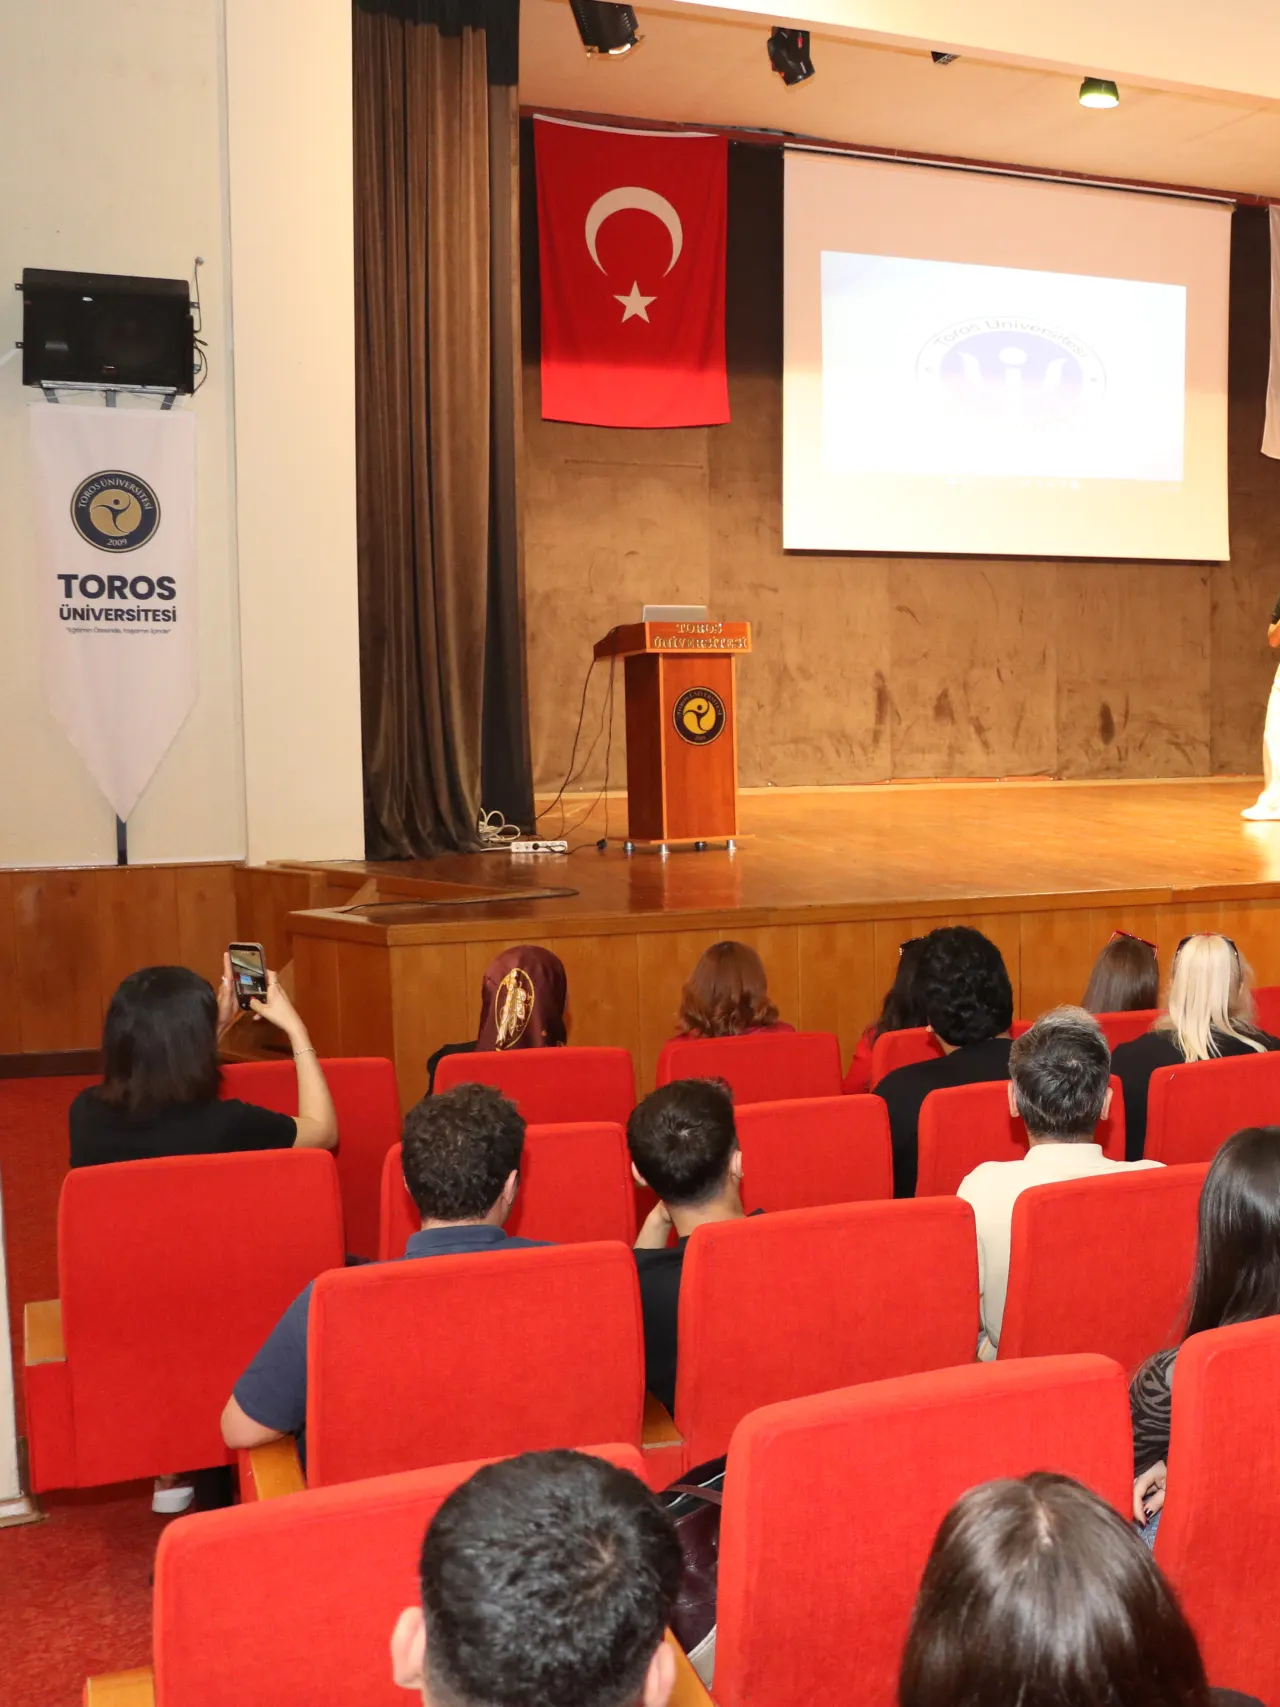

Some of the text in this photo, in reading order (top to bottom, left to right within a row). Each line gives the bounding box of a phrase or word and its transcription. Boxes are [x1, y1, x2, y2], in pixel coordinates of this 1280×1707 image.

[933, 322, 981, 348] Toros
[78, 481, 101, 509] TOROS
[106, 537, 128, 547] 2009
[57, 573, 177, 601] TOROS
[59, 603, 177, 623] ÜNİVERSİTESİ
[676, 623, 723, 634] TOROS
